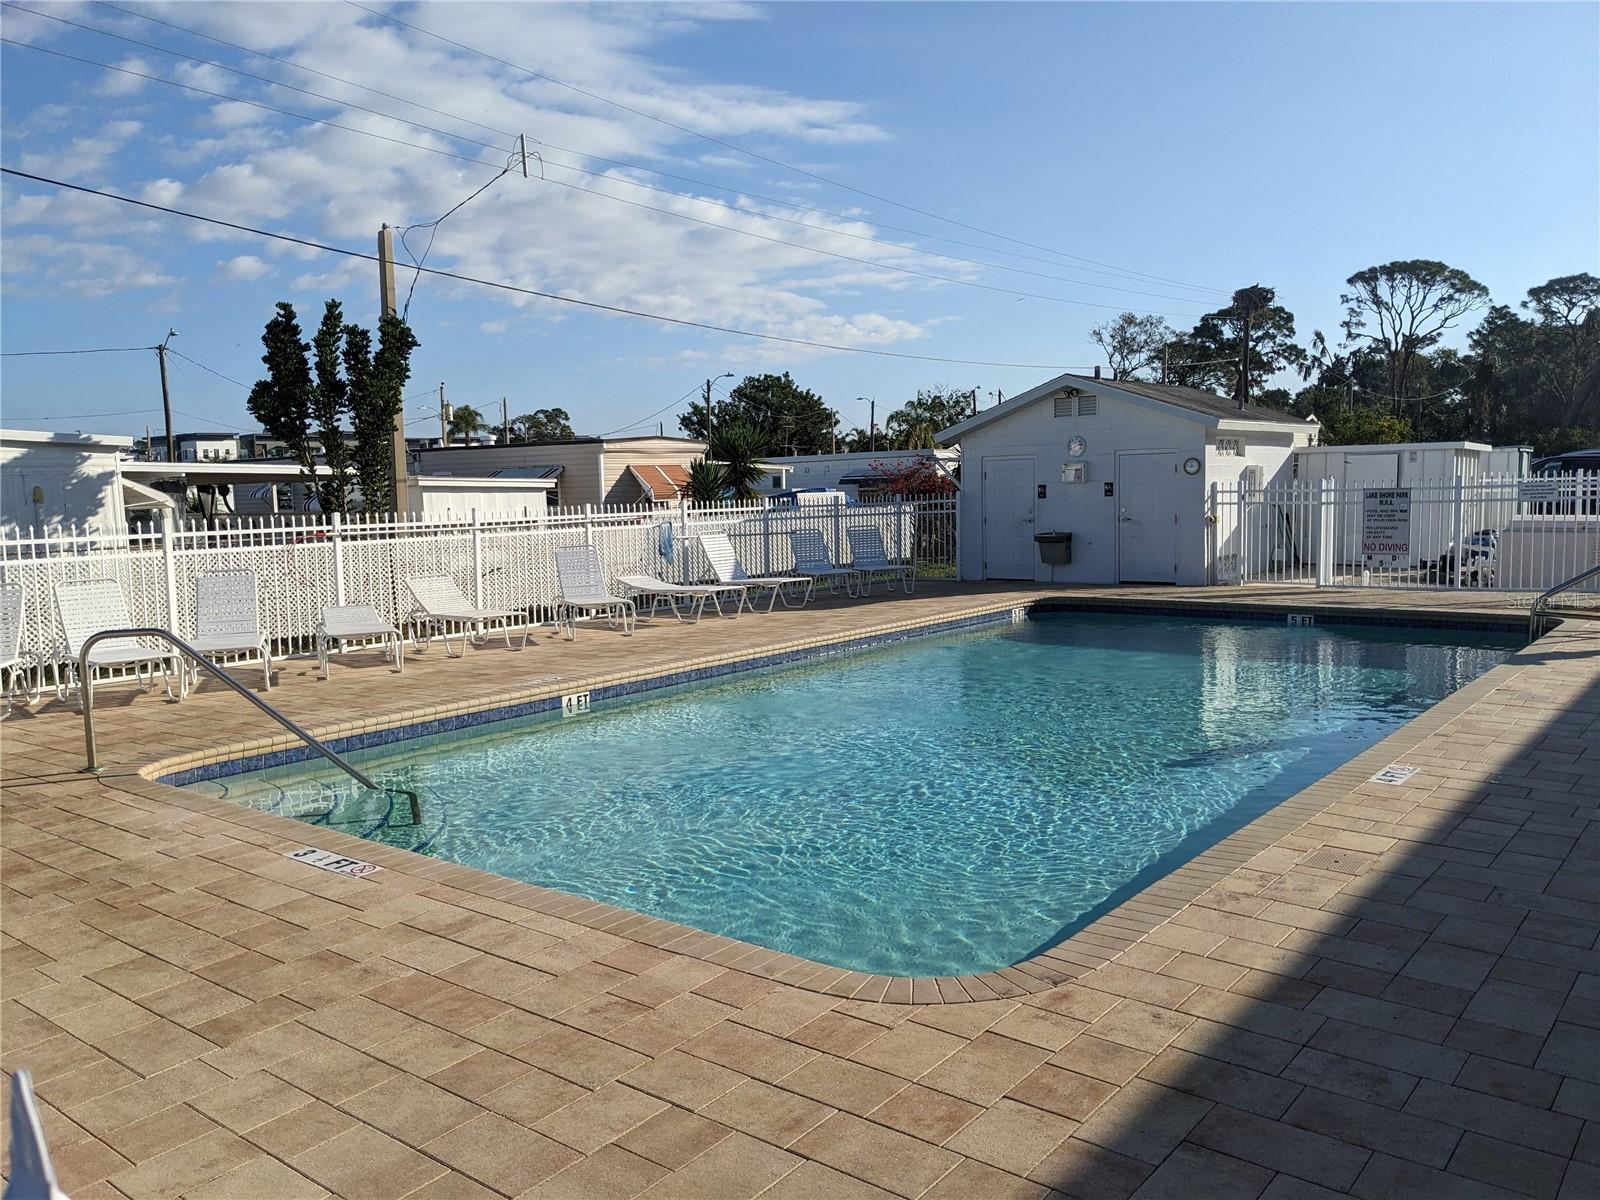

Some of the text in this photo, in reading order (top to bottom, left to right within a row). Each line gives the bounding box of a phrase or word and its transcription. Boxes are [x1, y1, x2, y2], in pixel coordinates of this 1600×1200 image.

[1379, 543, 1408, 551] DIVING
[1291, 616, 1312, 624] 5 FT
[566, 694, 588, 706] 4 FT
[323, 858, 360, 869] FT
